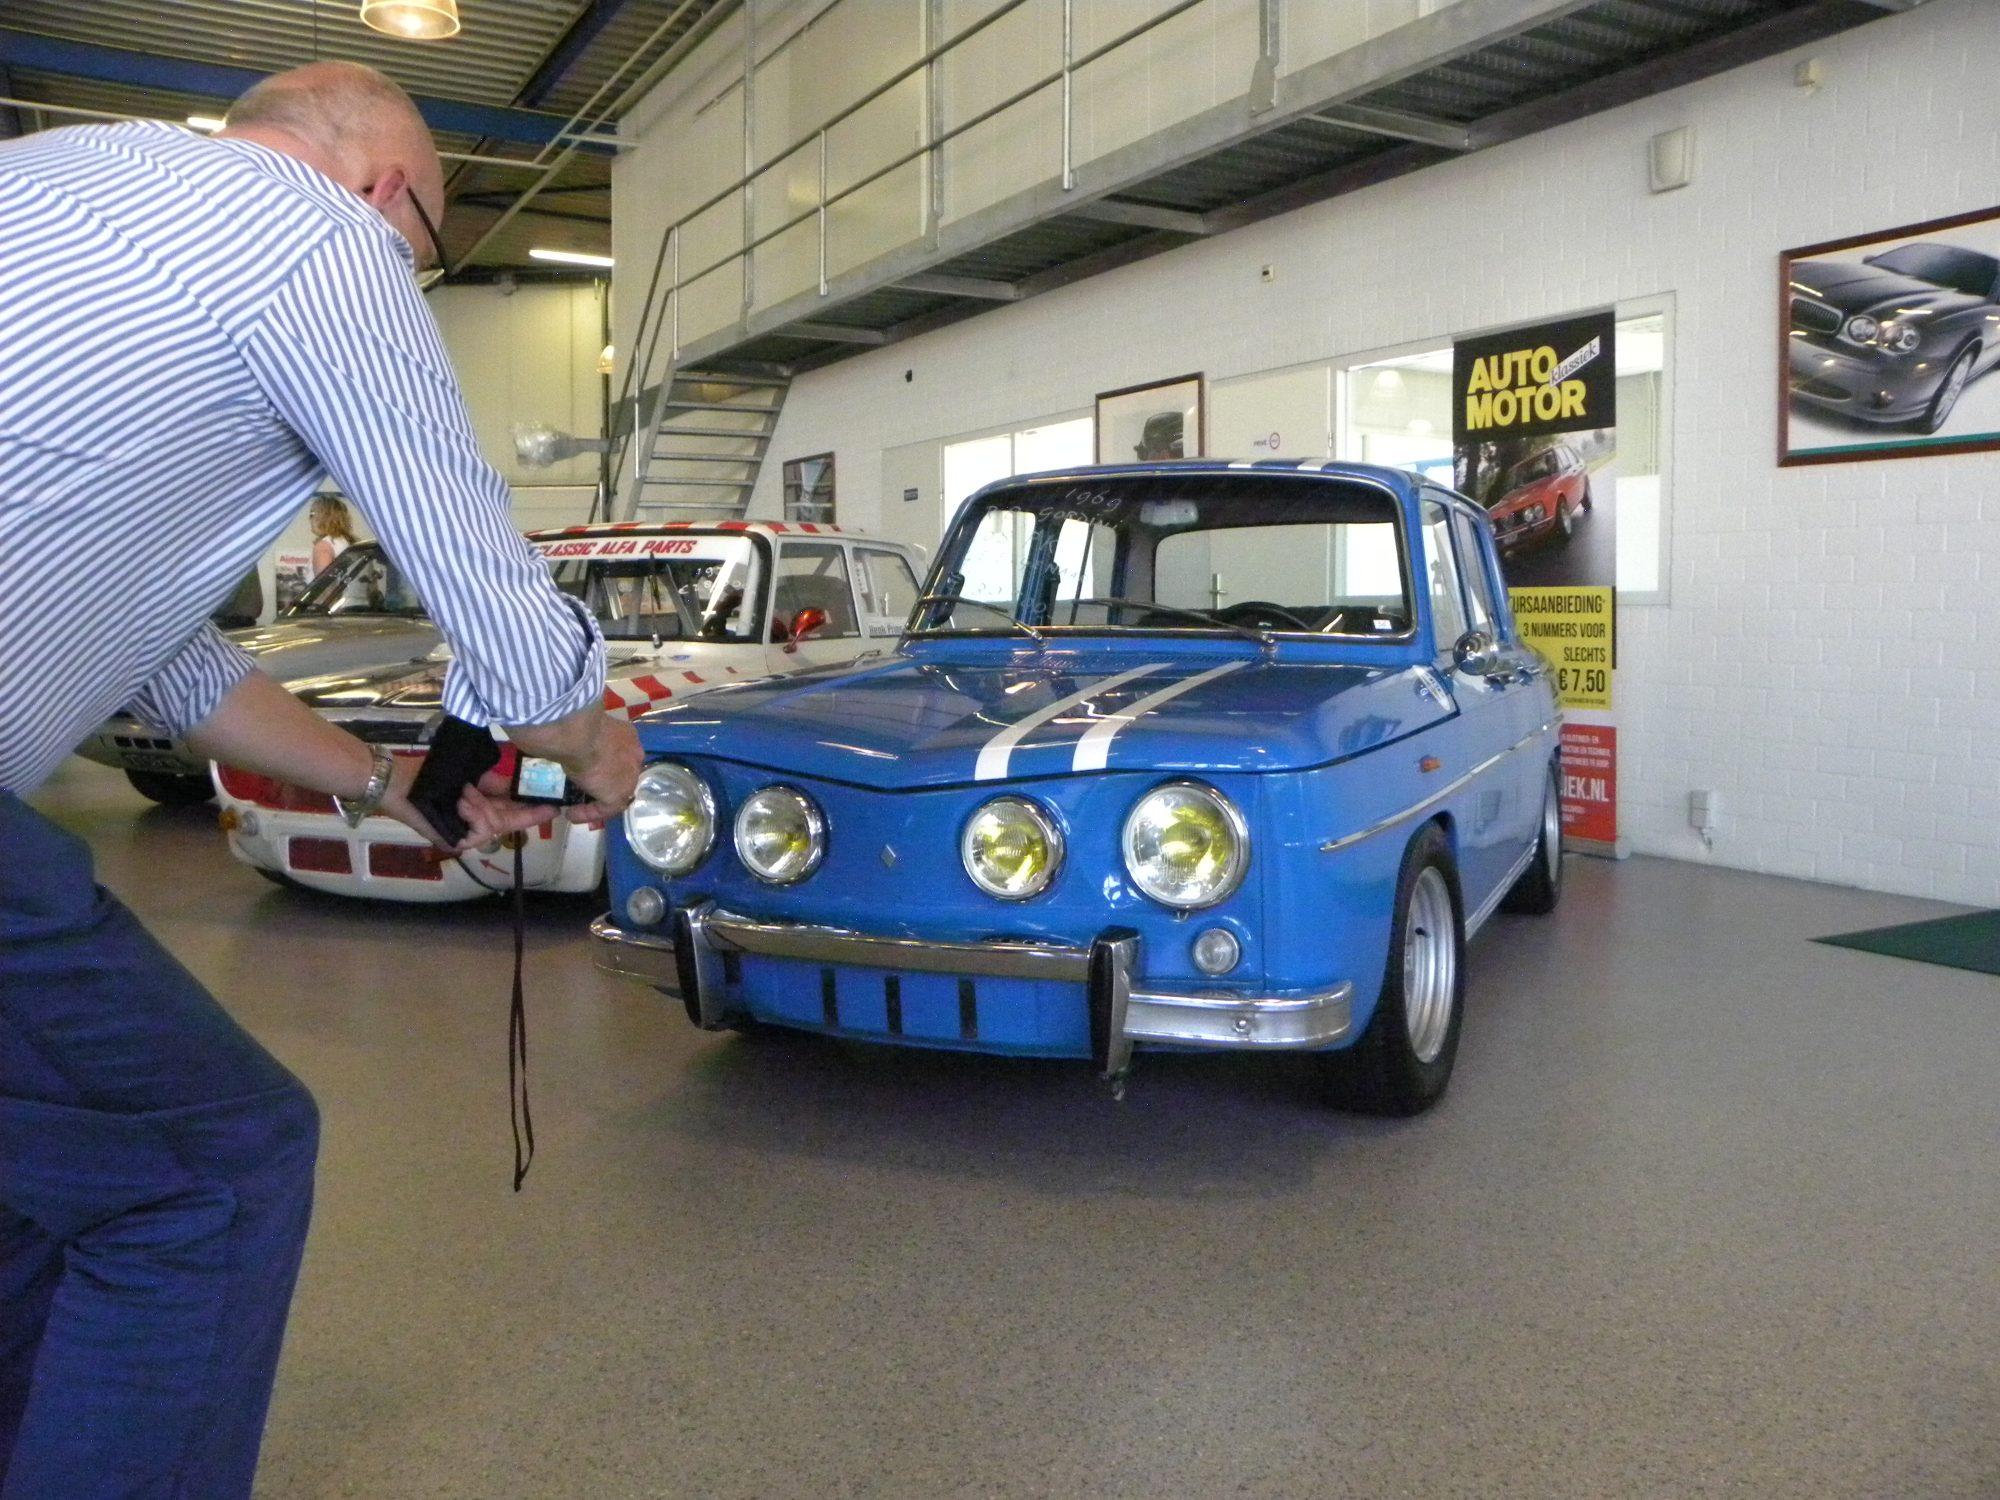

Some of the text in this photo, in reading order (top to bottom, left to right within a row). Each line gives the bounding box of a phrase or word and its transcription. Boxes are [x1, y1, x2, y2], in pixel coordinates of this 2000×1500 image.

[1467, 345, 1557, 394] AUTO
[1551, 342, 1597, 385] klassiek
[1467, 379, 1587, 430] MOTOR
[1065, 488, 1121, 512] 1969
[596, 541, 632, 555] ALFA
[640, 540, 697, 554] PARTS
[1523, 622, 1606, 638] 3 NUMMERS VOOR
[1563, 647, 1606, 662] SLECHTS
[1559, 668, 1606, 694] € 7,50
